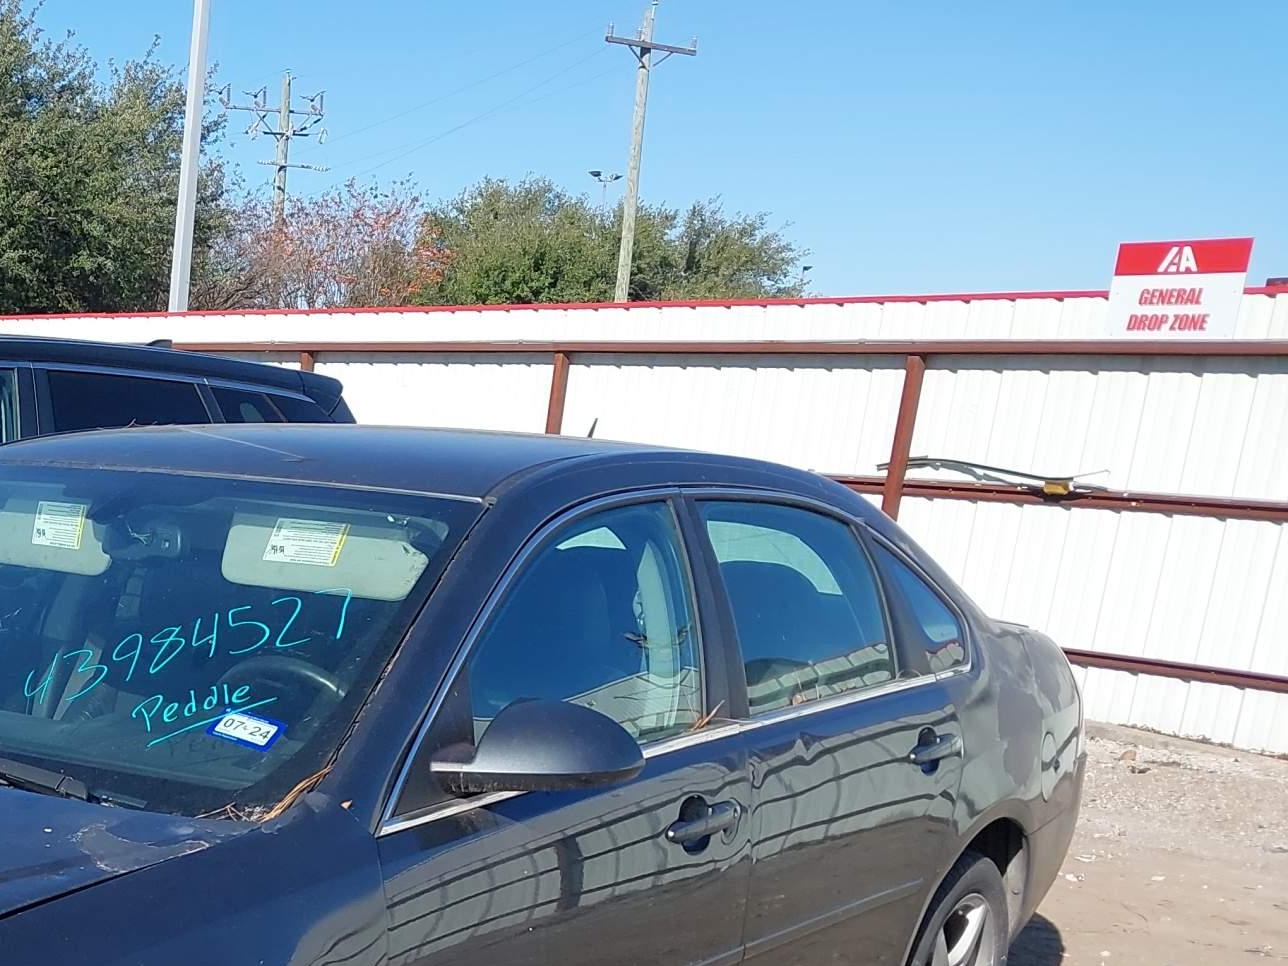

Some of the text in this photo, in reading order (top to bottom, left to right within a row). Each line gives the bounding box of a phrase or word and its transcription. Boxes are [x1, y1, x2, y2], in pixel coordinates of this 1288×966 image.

[1138, 288, 1203, 306] GENERAL
[1126, 313, 1210, 331] DROP ZONE
[24, 588, 352, 704] 43984527
[132, 684, 251, 732] Peddle
